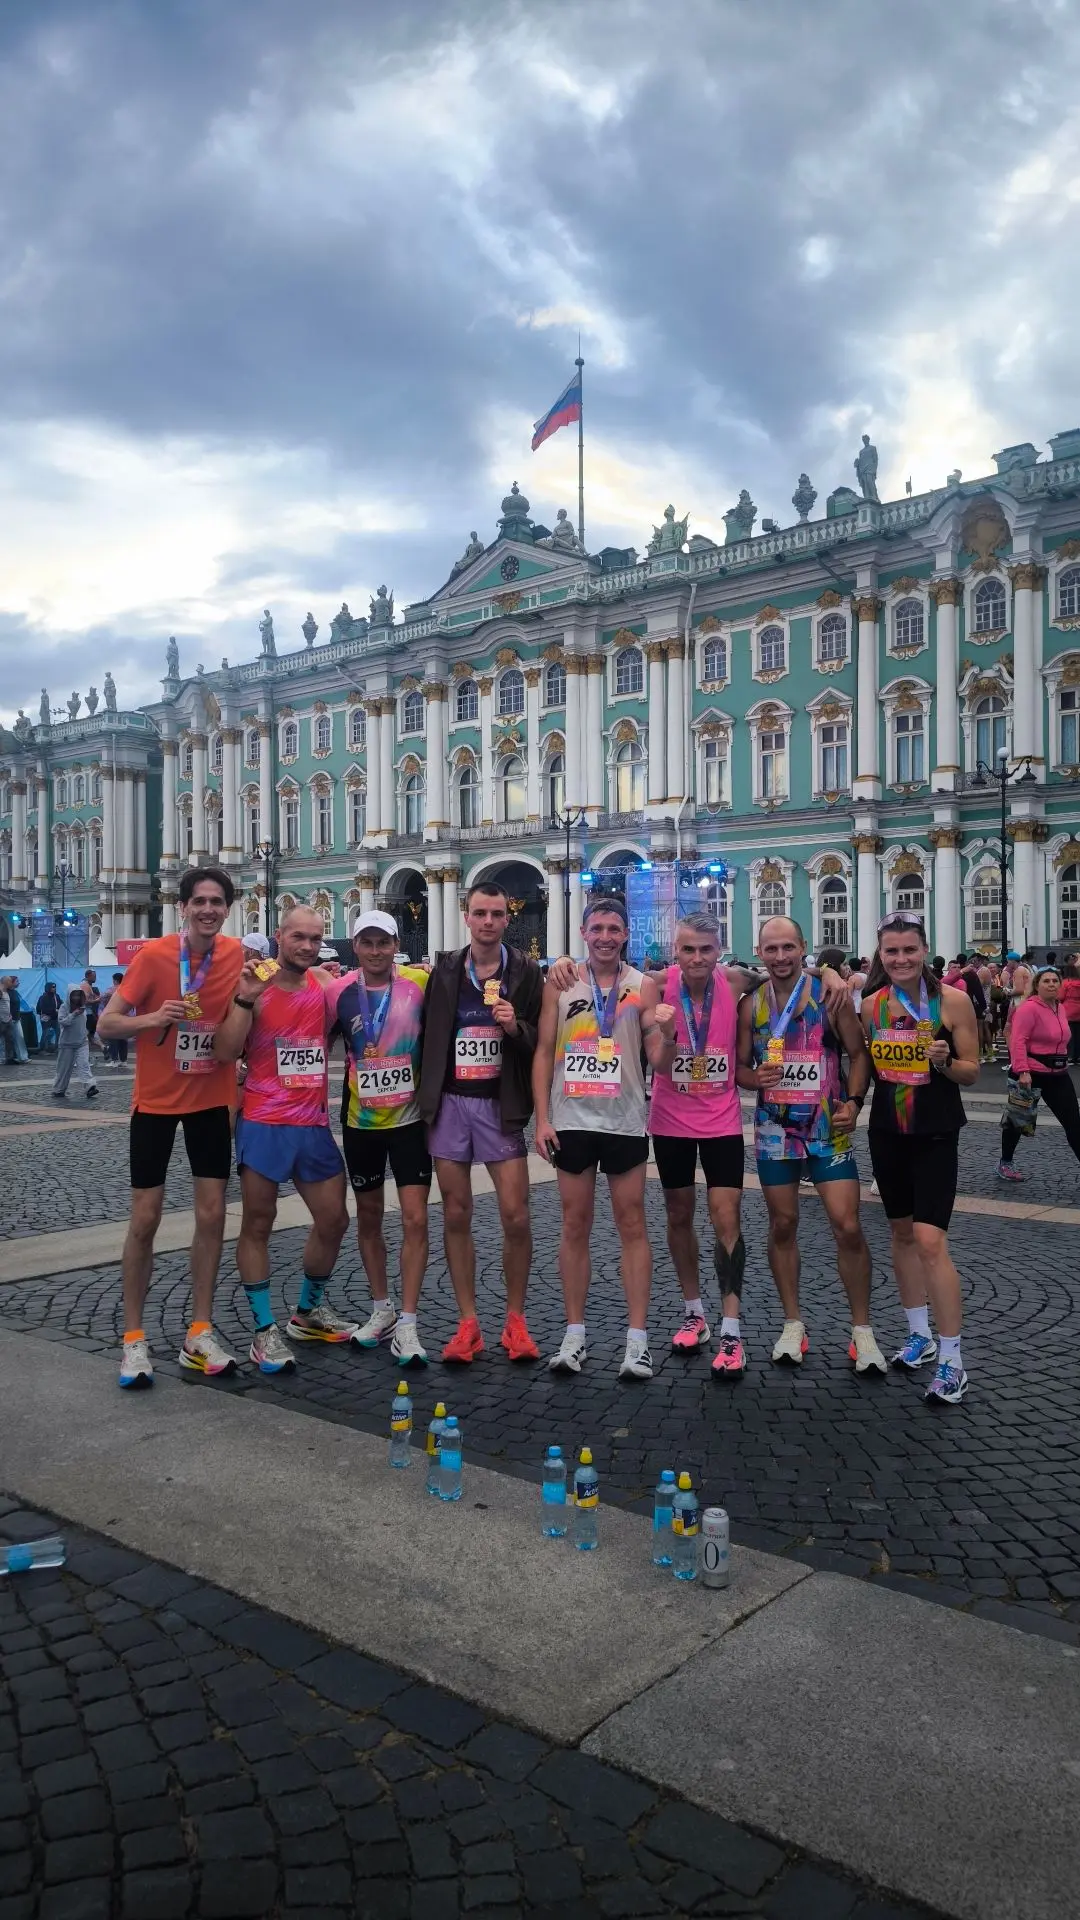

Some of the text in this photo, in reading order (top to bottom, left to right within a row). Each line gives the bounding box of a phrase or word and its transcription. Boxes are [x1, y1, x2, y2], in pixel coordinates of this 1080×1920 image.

[630, 916, 671, 932] БЕЛЫЕ
[630, 932, 671, 947] НОЧИ
[280, 1049, 324, 1066] 27554
[873, 1044, 926, 1062] 32038
[674, 1057, 727, 1073] 2326
[780, 1064, 818, 1081] 466
[359, 1067, 412, 1089] 21698
[704, 1541, 720, 1571] 0
